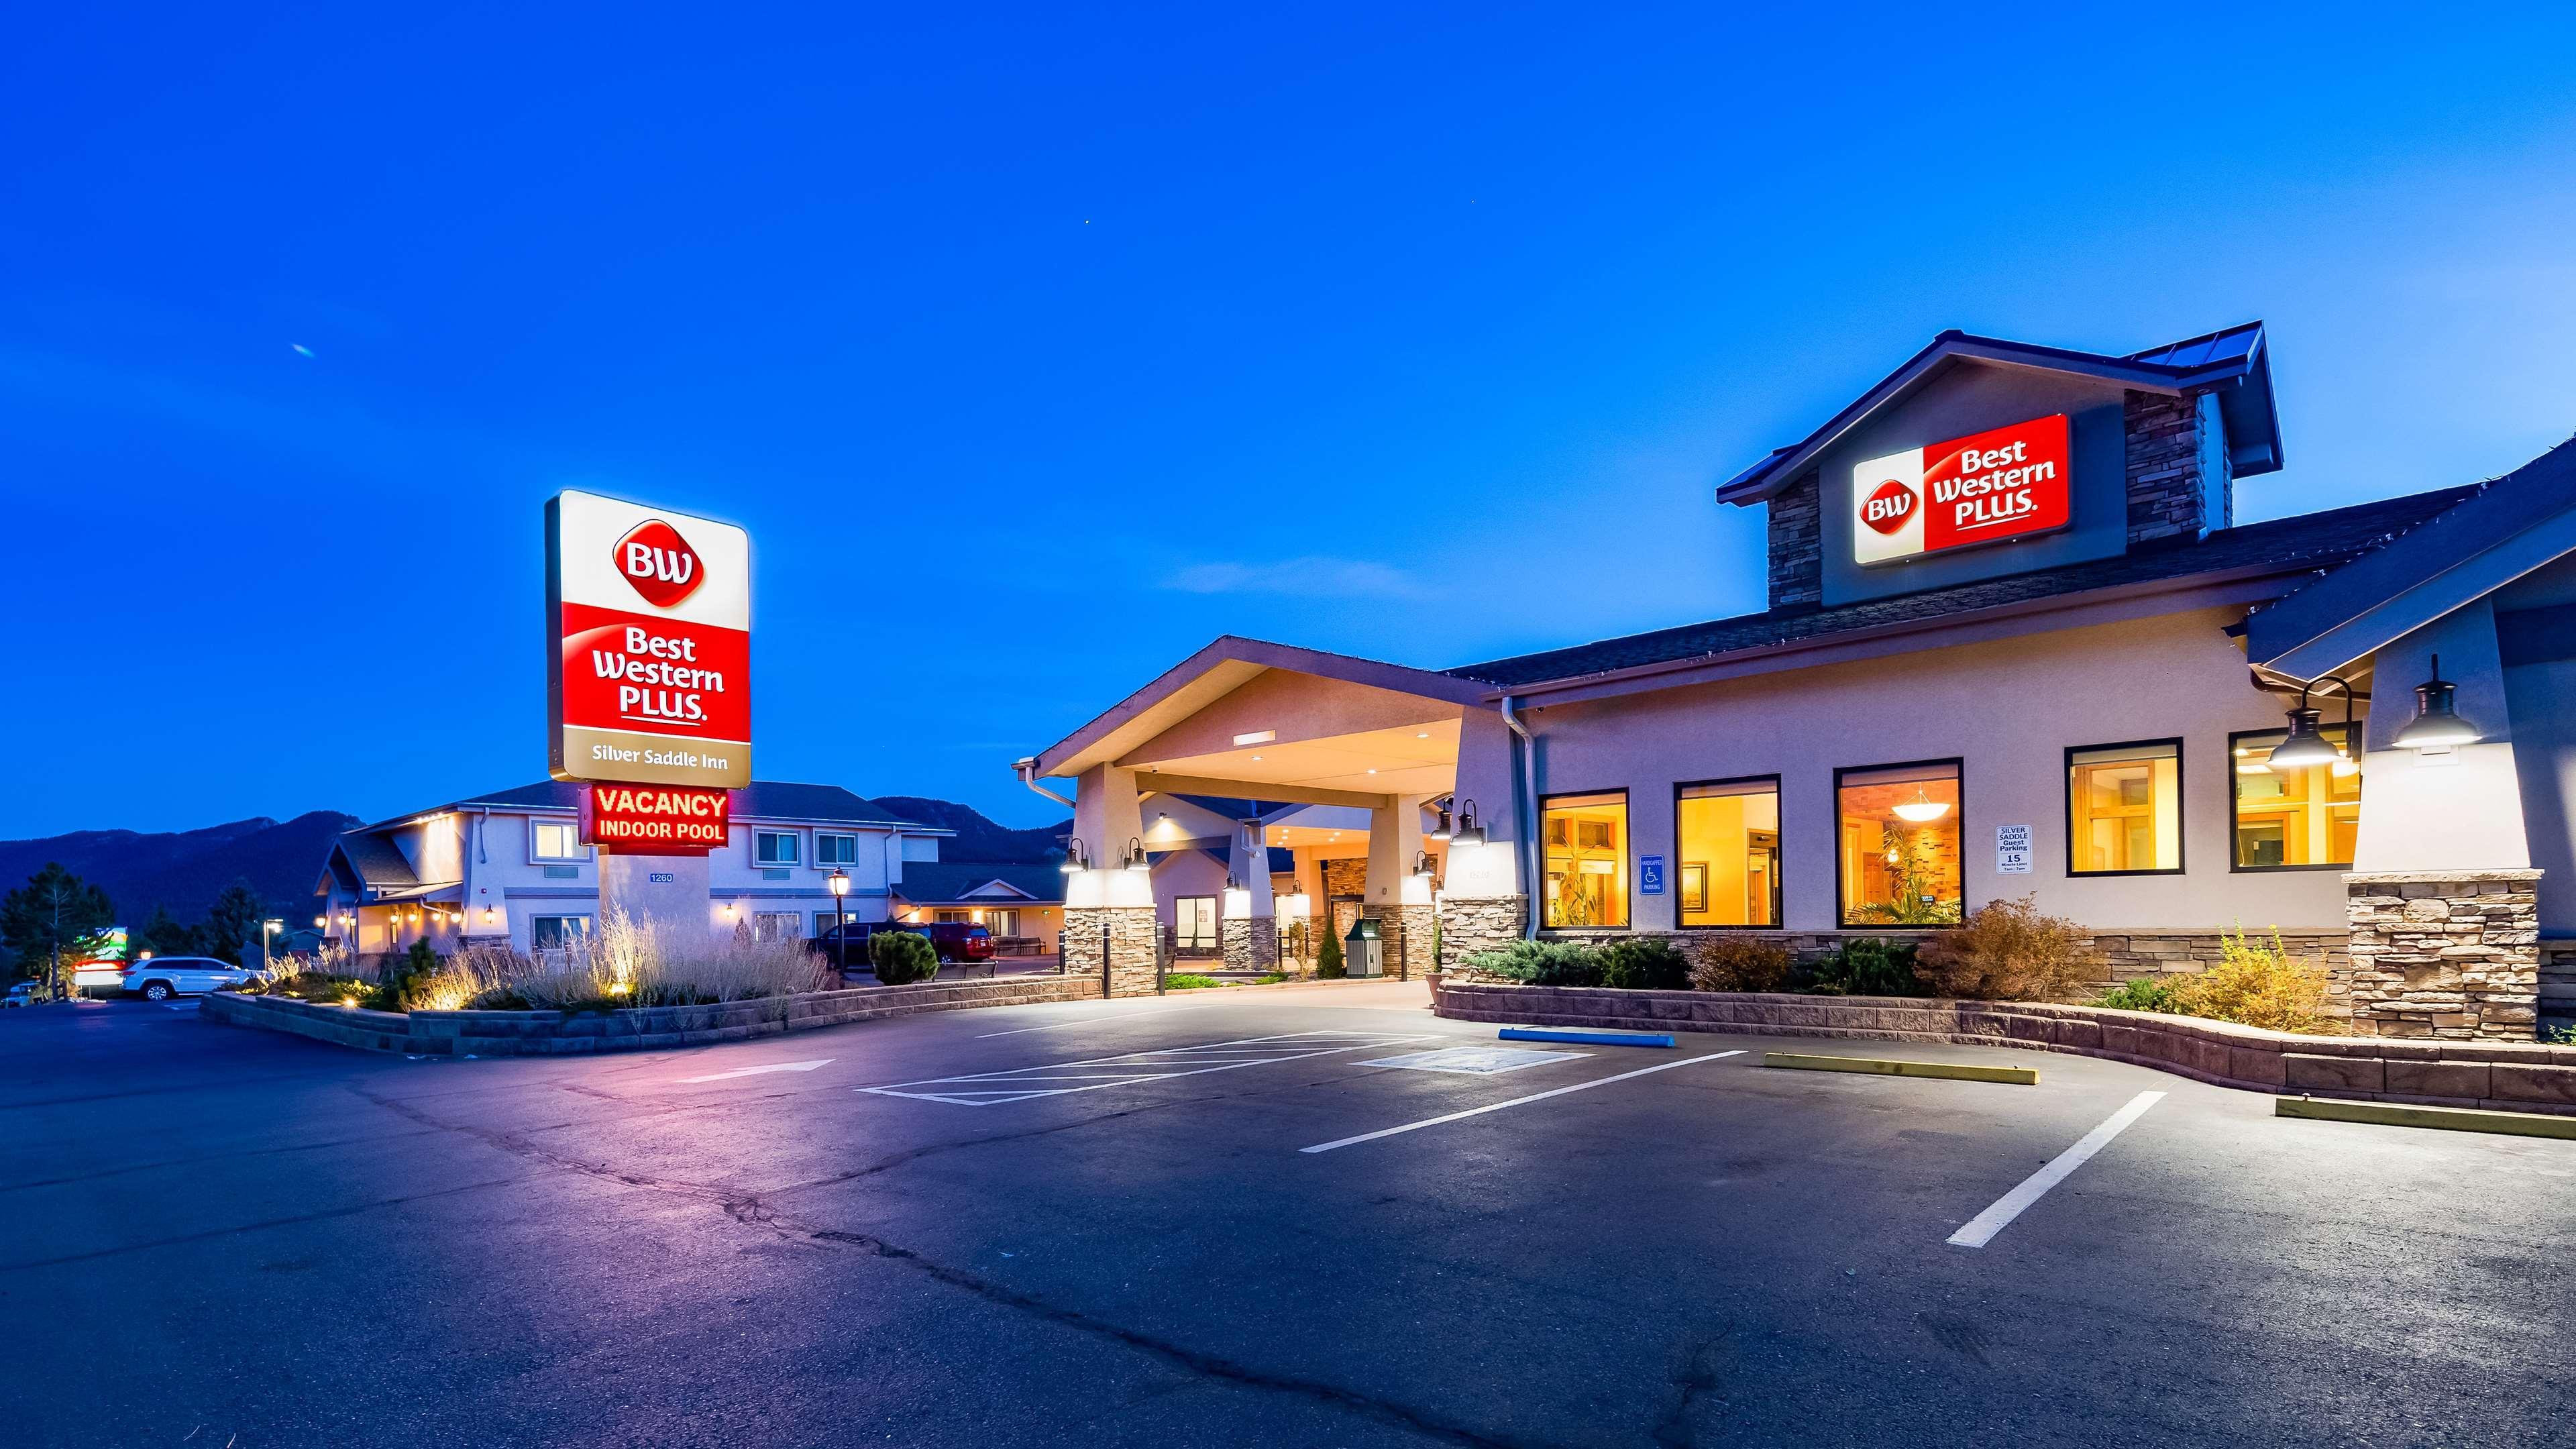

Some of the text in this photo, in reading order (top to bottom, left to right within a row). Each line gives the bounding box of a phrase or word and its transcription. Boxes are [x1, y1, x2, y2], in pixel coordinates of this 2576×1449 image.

[1962, 441, 2027, 475] Best
[1933, 461, 2056, 504] Western
[1868, 493, 1911, 521] BW
[627, 542, 692, 584] BW
[626, 627, 696, 662] Best
[592, 649, 724, 692] Western
[592, 745, 729, 769] Silver Saddle Inn
[597, 788, 727, 817] VACANCY
[600, 820, 724, 840] INDOOR POOL
[2007, 854, 2021, 863] 15
[651, 874, 672, 882] 1260
